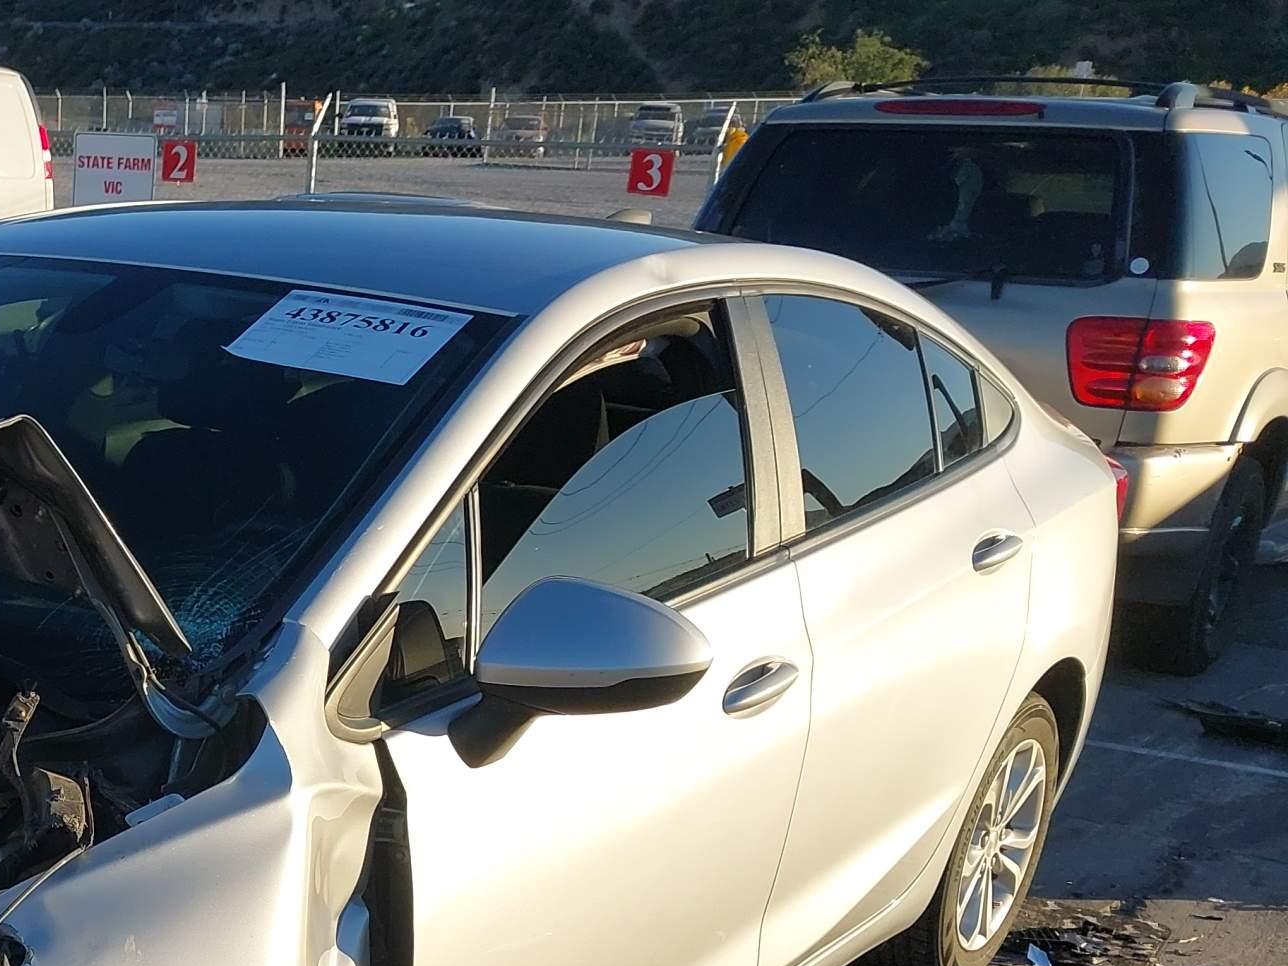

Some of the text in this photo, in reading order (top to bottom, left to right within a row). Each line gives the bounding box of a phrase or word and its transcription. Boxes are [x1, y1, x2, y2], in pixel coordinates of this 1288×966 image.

[77, 155, 152, 171] STATE FARM
[168, 145, 188, 179] 2
[637, 153, 663, 191] 3
[103, 180, 123, 195] VIC
[285, 306, 433, 339] 43875816
